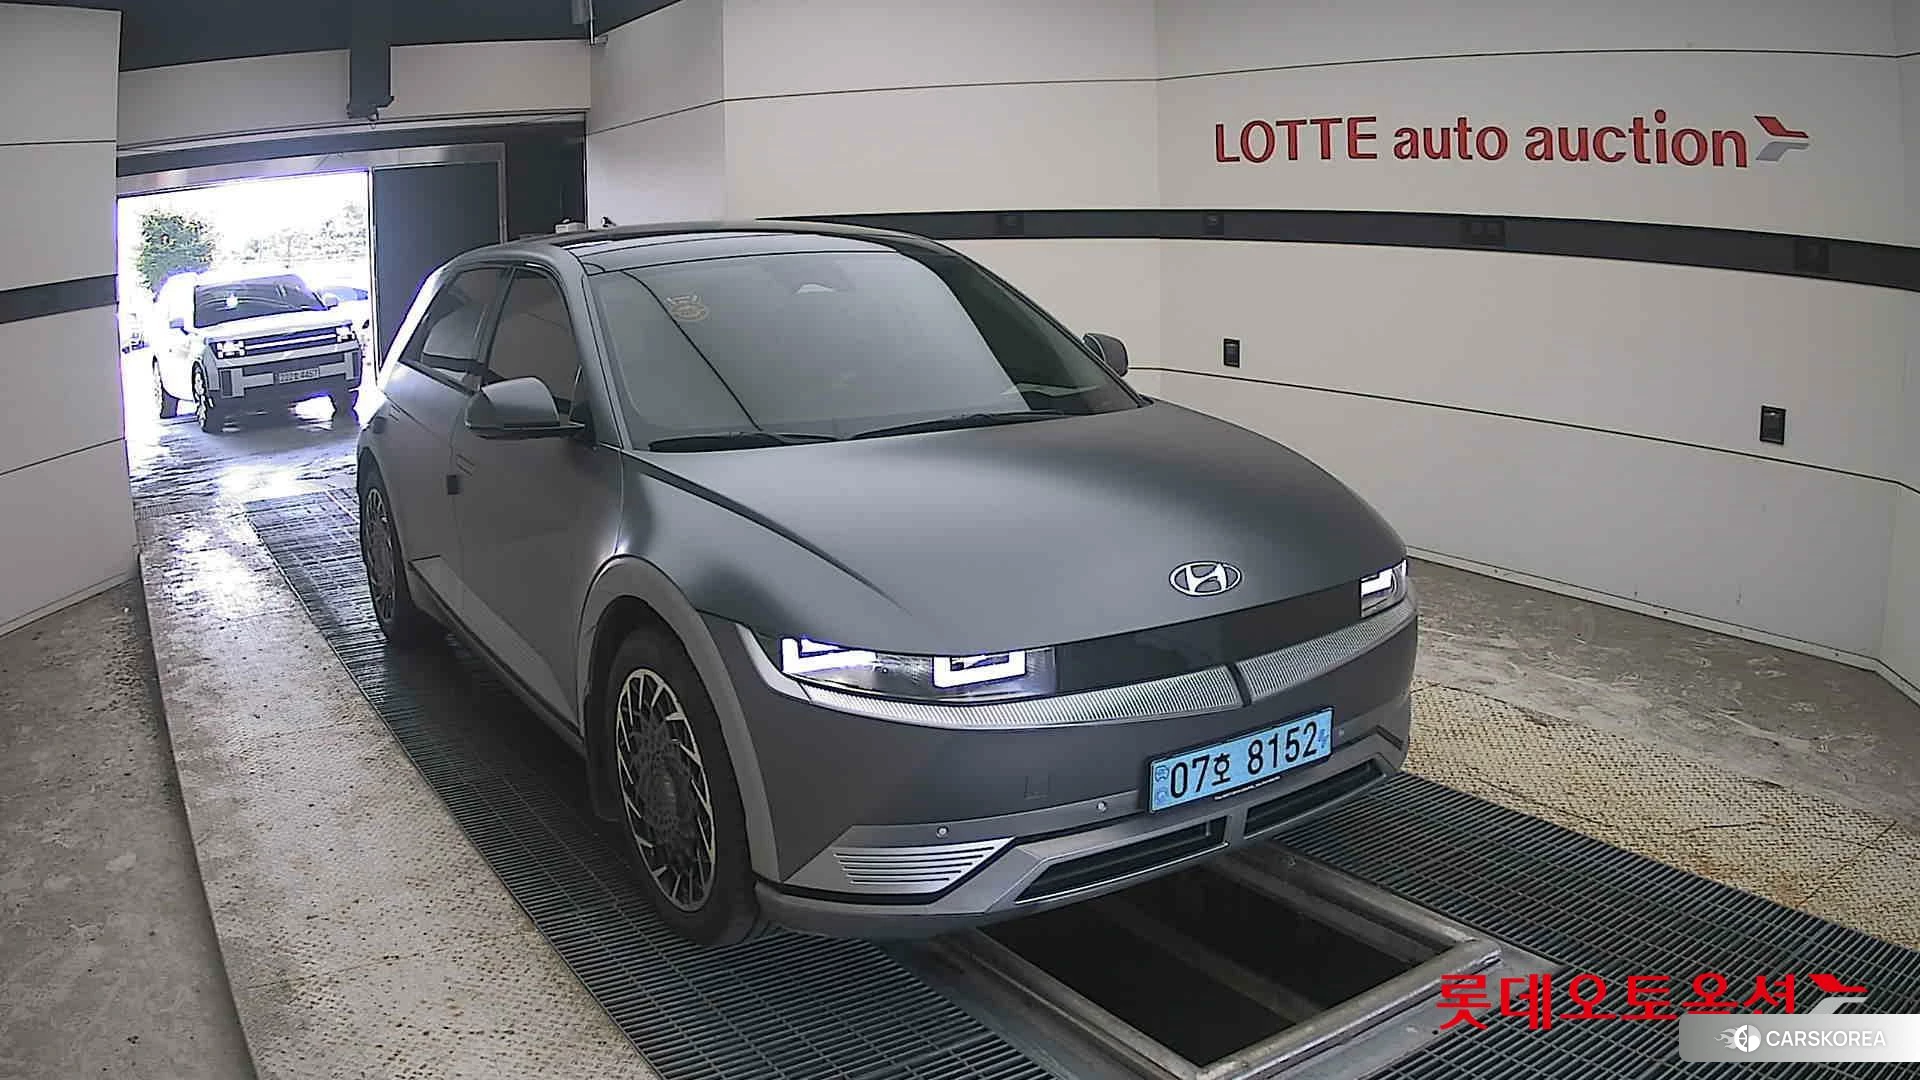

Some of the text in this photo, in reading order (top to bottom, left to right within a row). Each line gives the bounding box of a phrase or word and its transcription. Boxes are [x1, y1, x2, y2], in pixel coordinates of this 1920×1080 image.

[1214, 109, 1748, 168] LOTTE auto auction
[1170, 721, 1318, 799] 07호 8152
